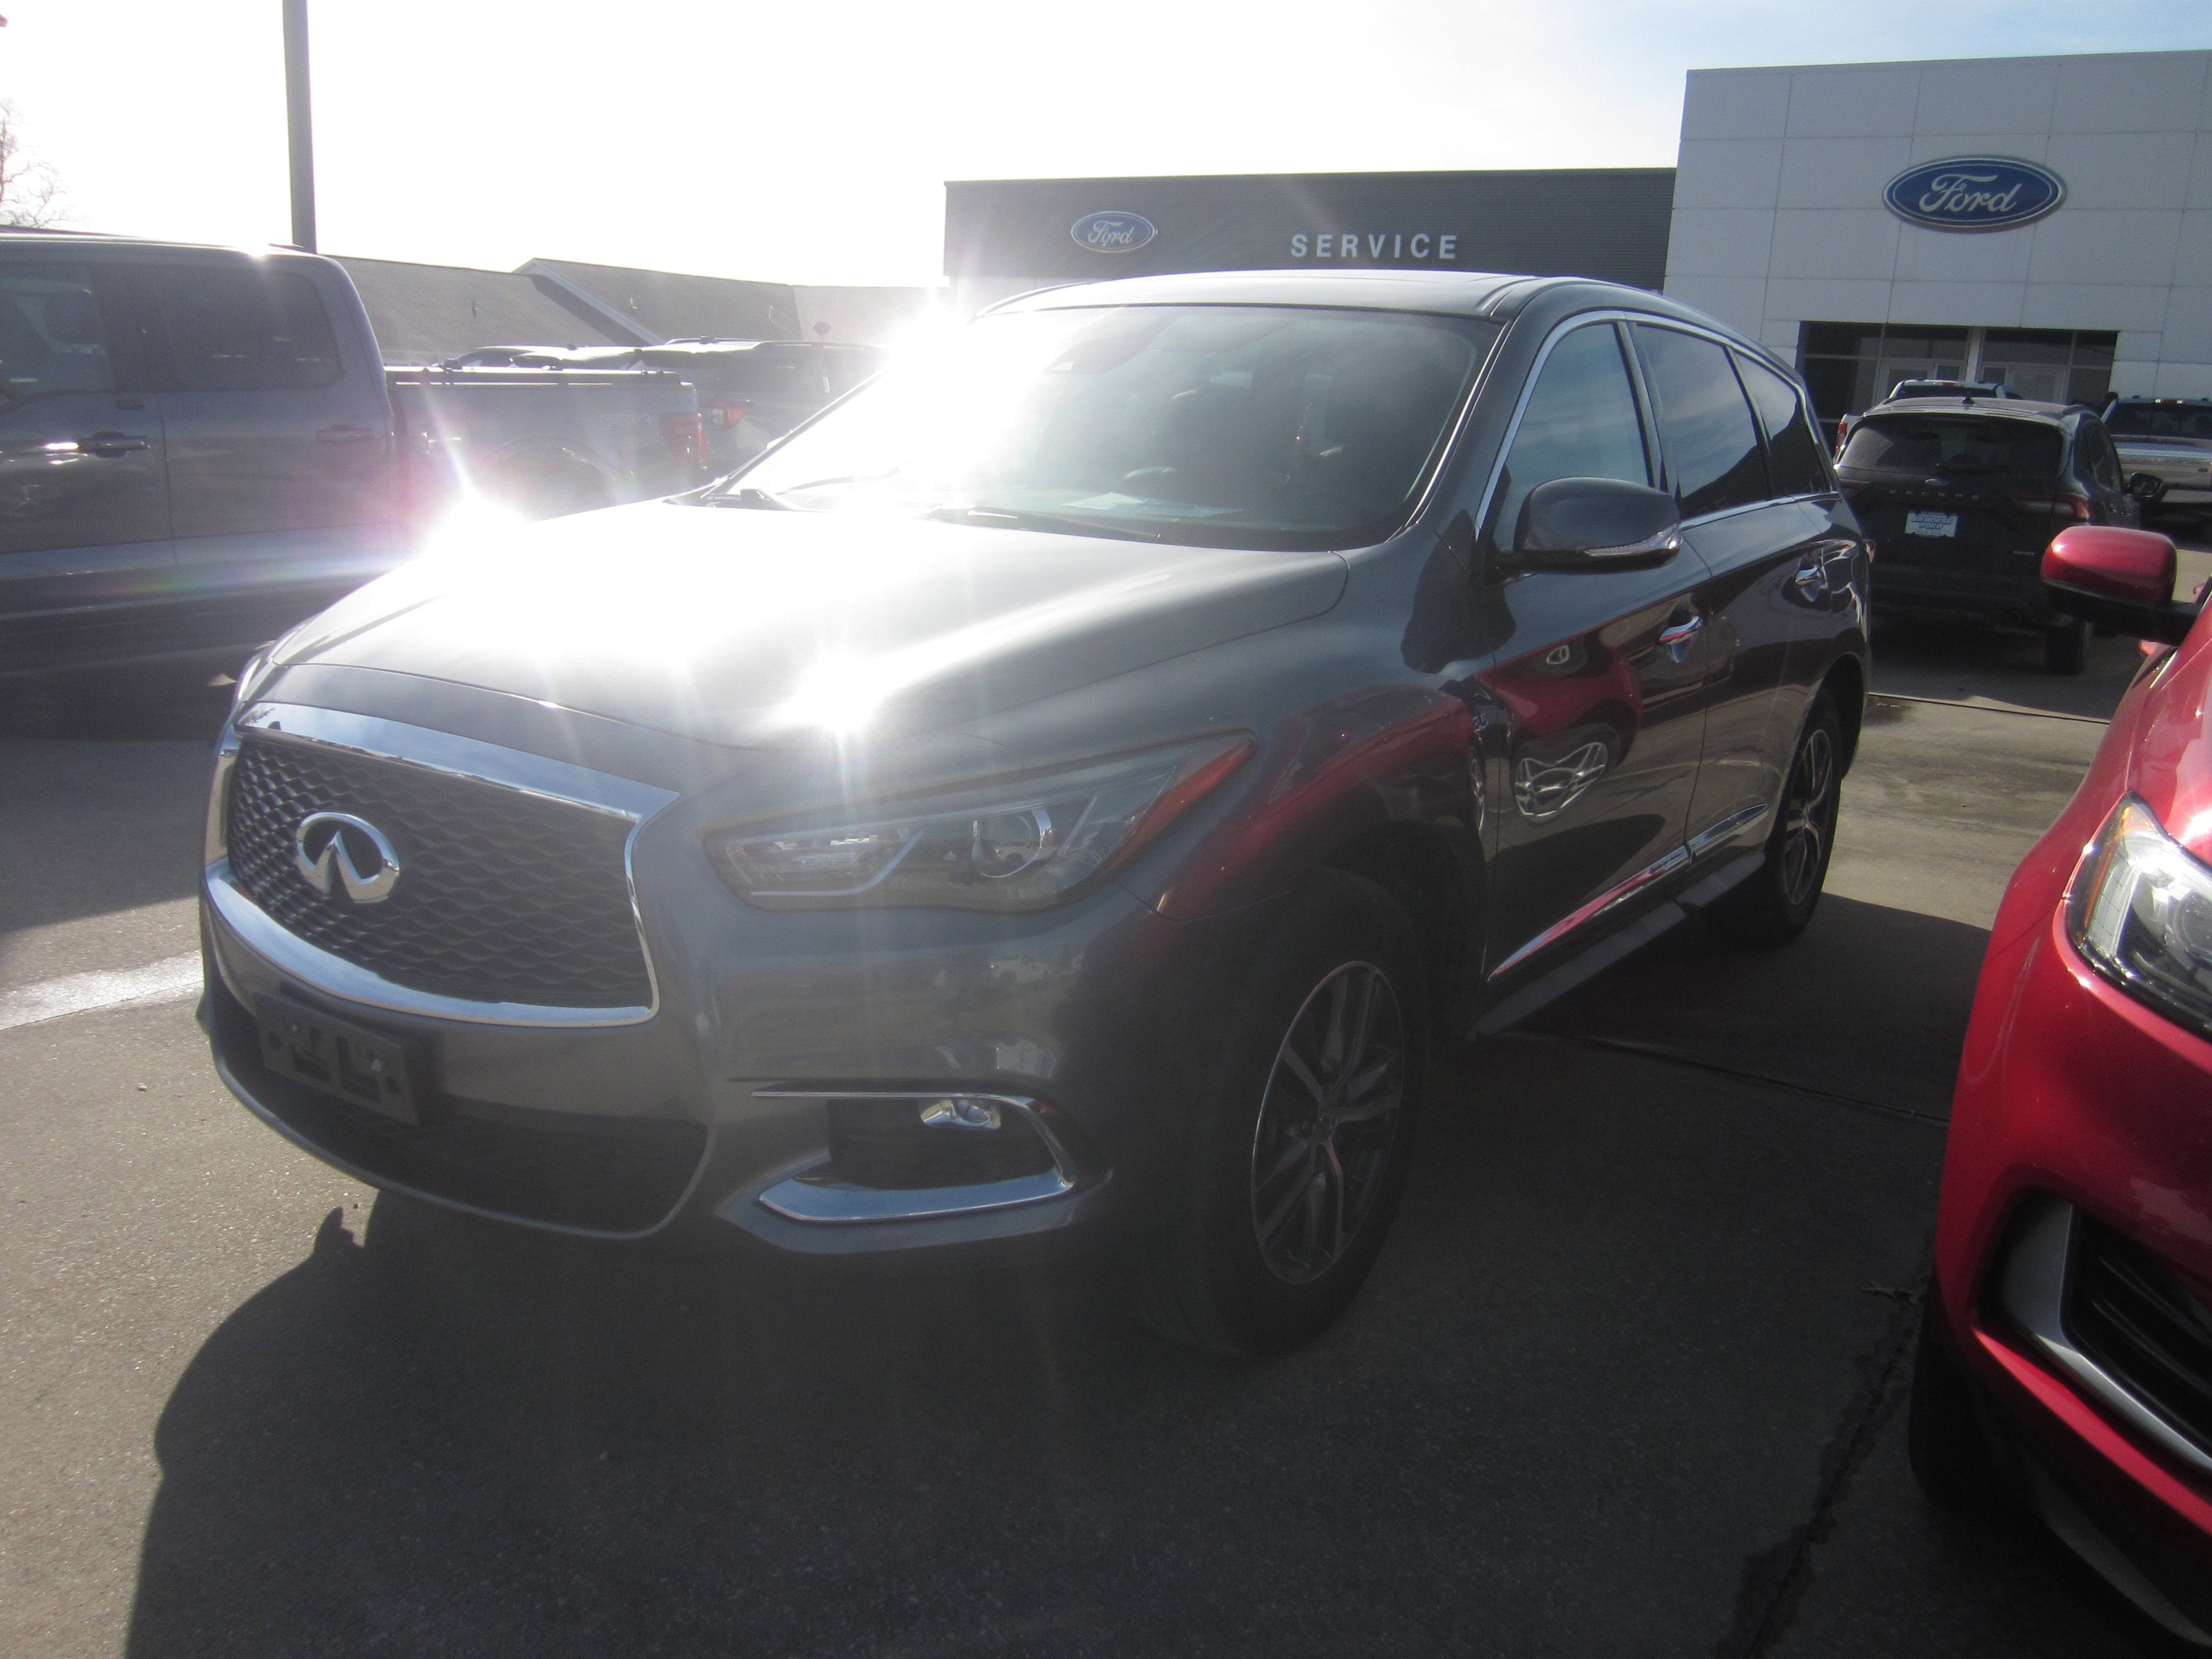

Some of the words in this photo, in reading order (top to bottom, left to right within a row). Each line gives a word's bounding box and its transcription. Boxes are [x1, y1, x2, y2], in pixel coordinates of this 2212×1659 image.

[1919, 174, 2022, 212] Ford
[1088, 221, 1135, 243] Ford
[1291, 233, 1458, 259] SERVICE
